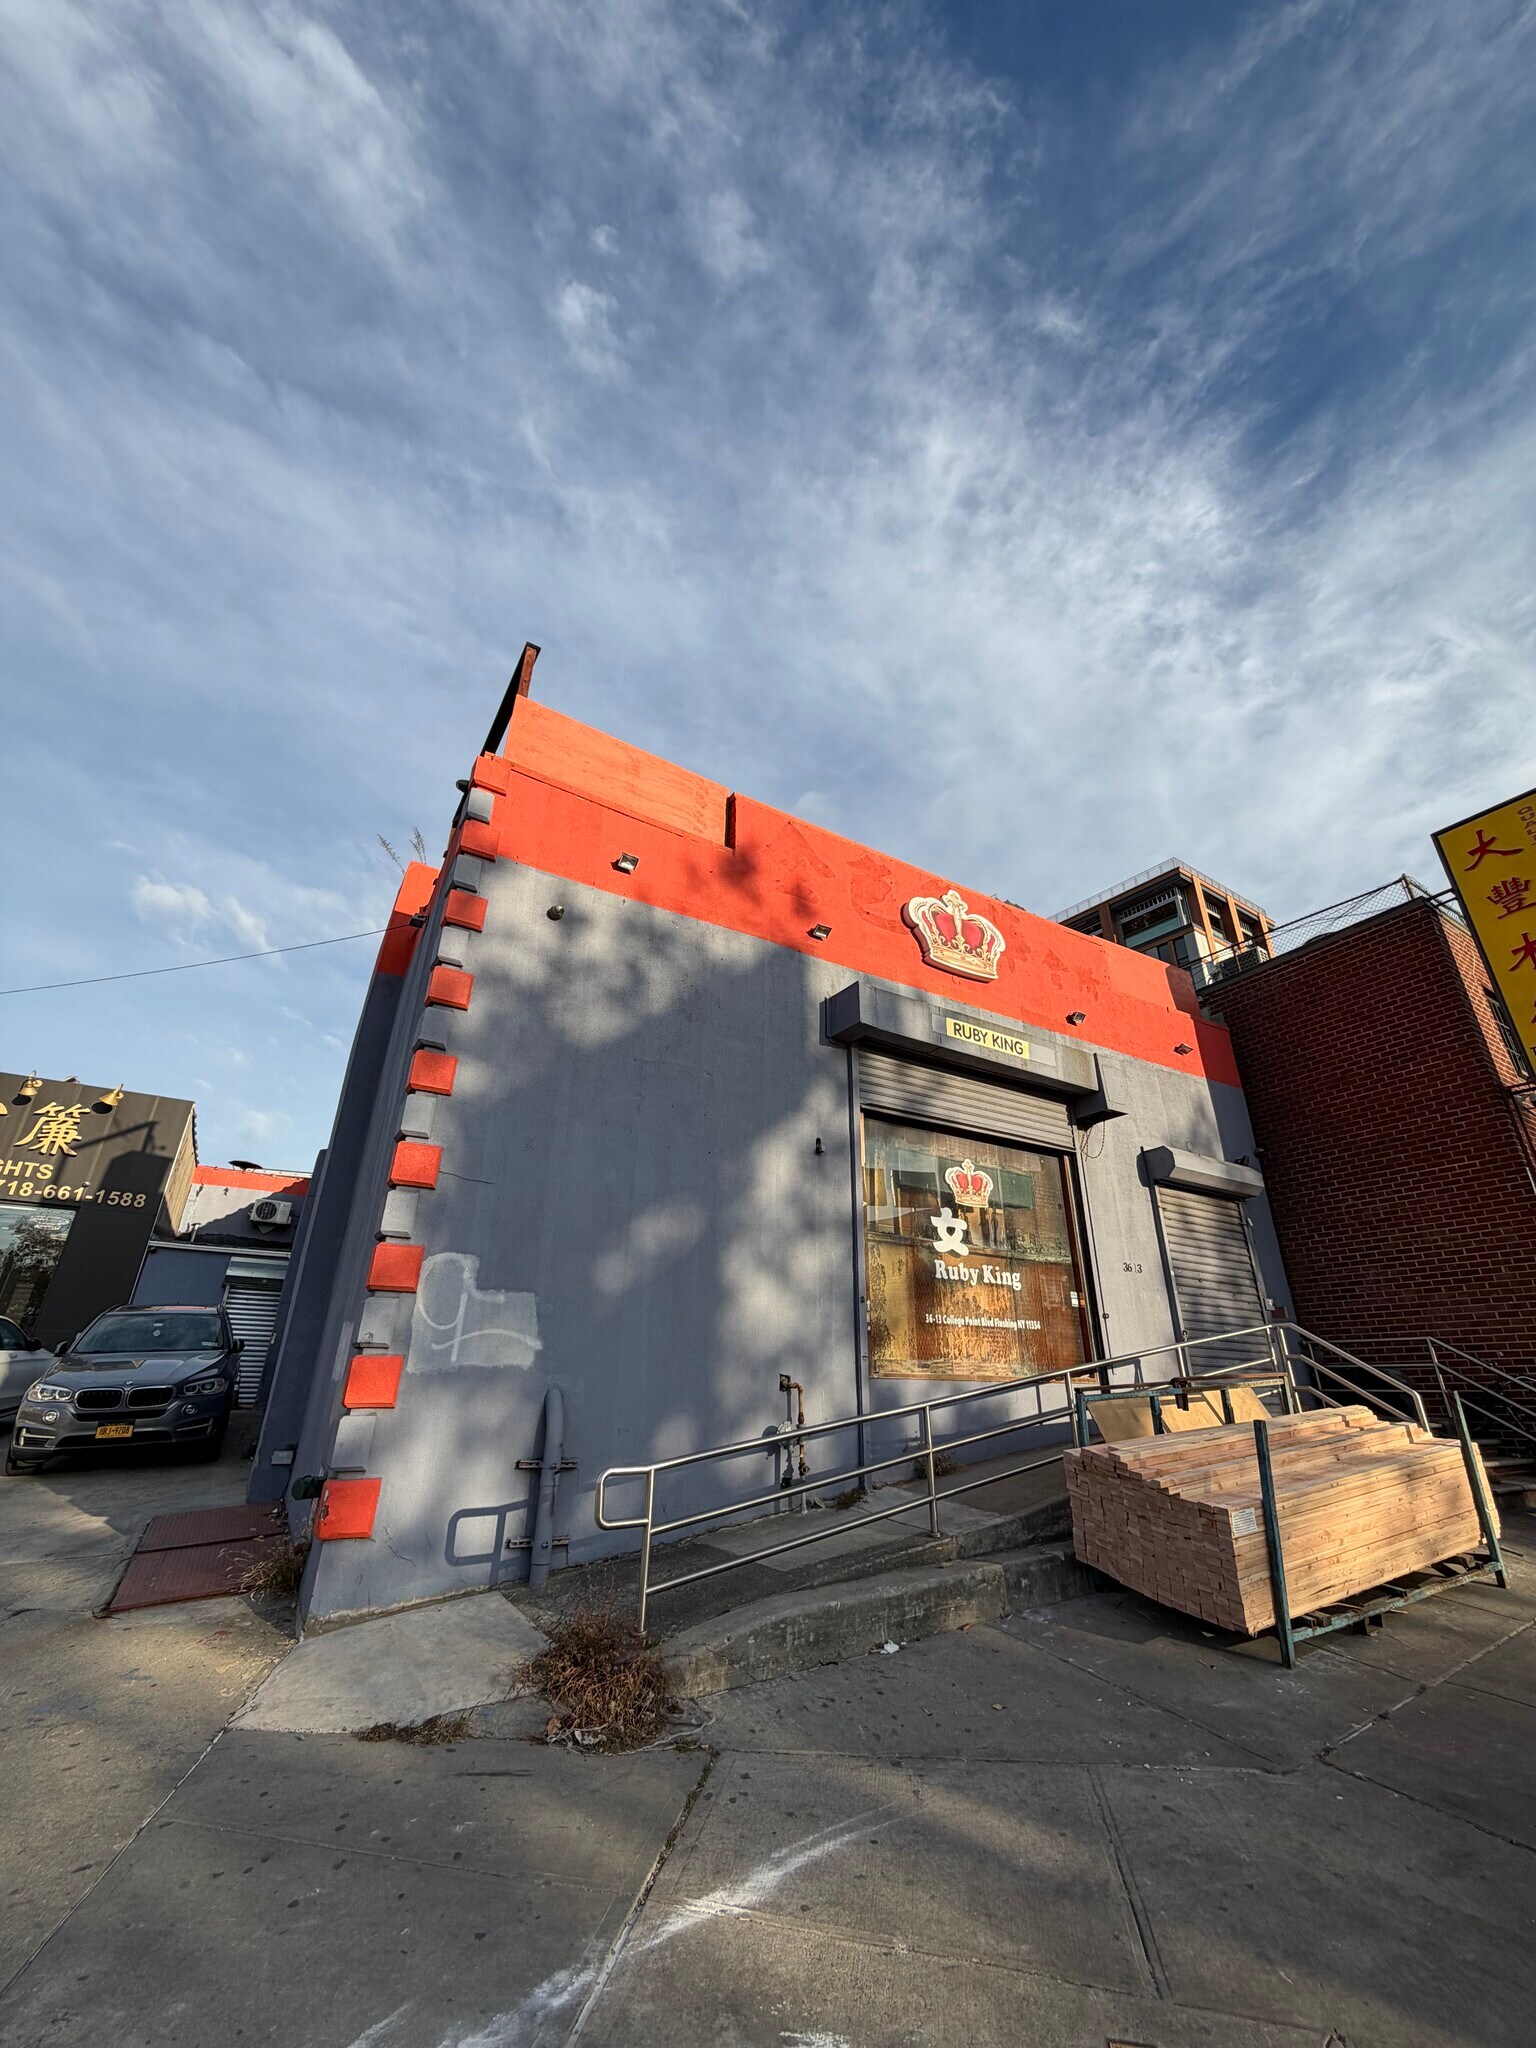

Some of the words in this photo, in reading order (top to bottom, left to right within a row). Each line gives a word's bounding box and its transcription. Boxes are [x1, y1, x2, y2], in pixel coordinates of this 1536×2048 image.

[1464, 829, 1536, 1024] 大豐木
[953, 1022, 988, 1044] RUBY
[991, 1033, 1024, 1055] KING
[0, 1101, 91, 1156] 簾
[934, 1259, 979, 1286] Ruby
[981, 1264, 1022, 1291] King
[925, 1313, 942, 1324] 36-13
[942, 1314, 965, 1328] College
[965, 1316, 981, 1326] Point
[980, 1317, 994, 1327] Blvd
[994, 1317, 1017, 1331] Flushing
[1017, 1319, 1026, 1329] NY
[1025, 1320, 1041, 1330] 11354
